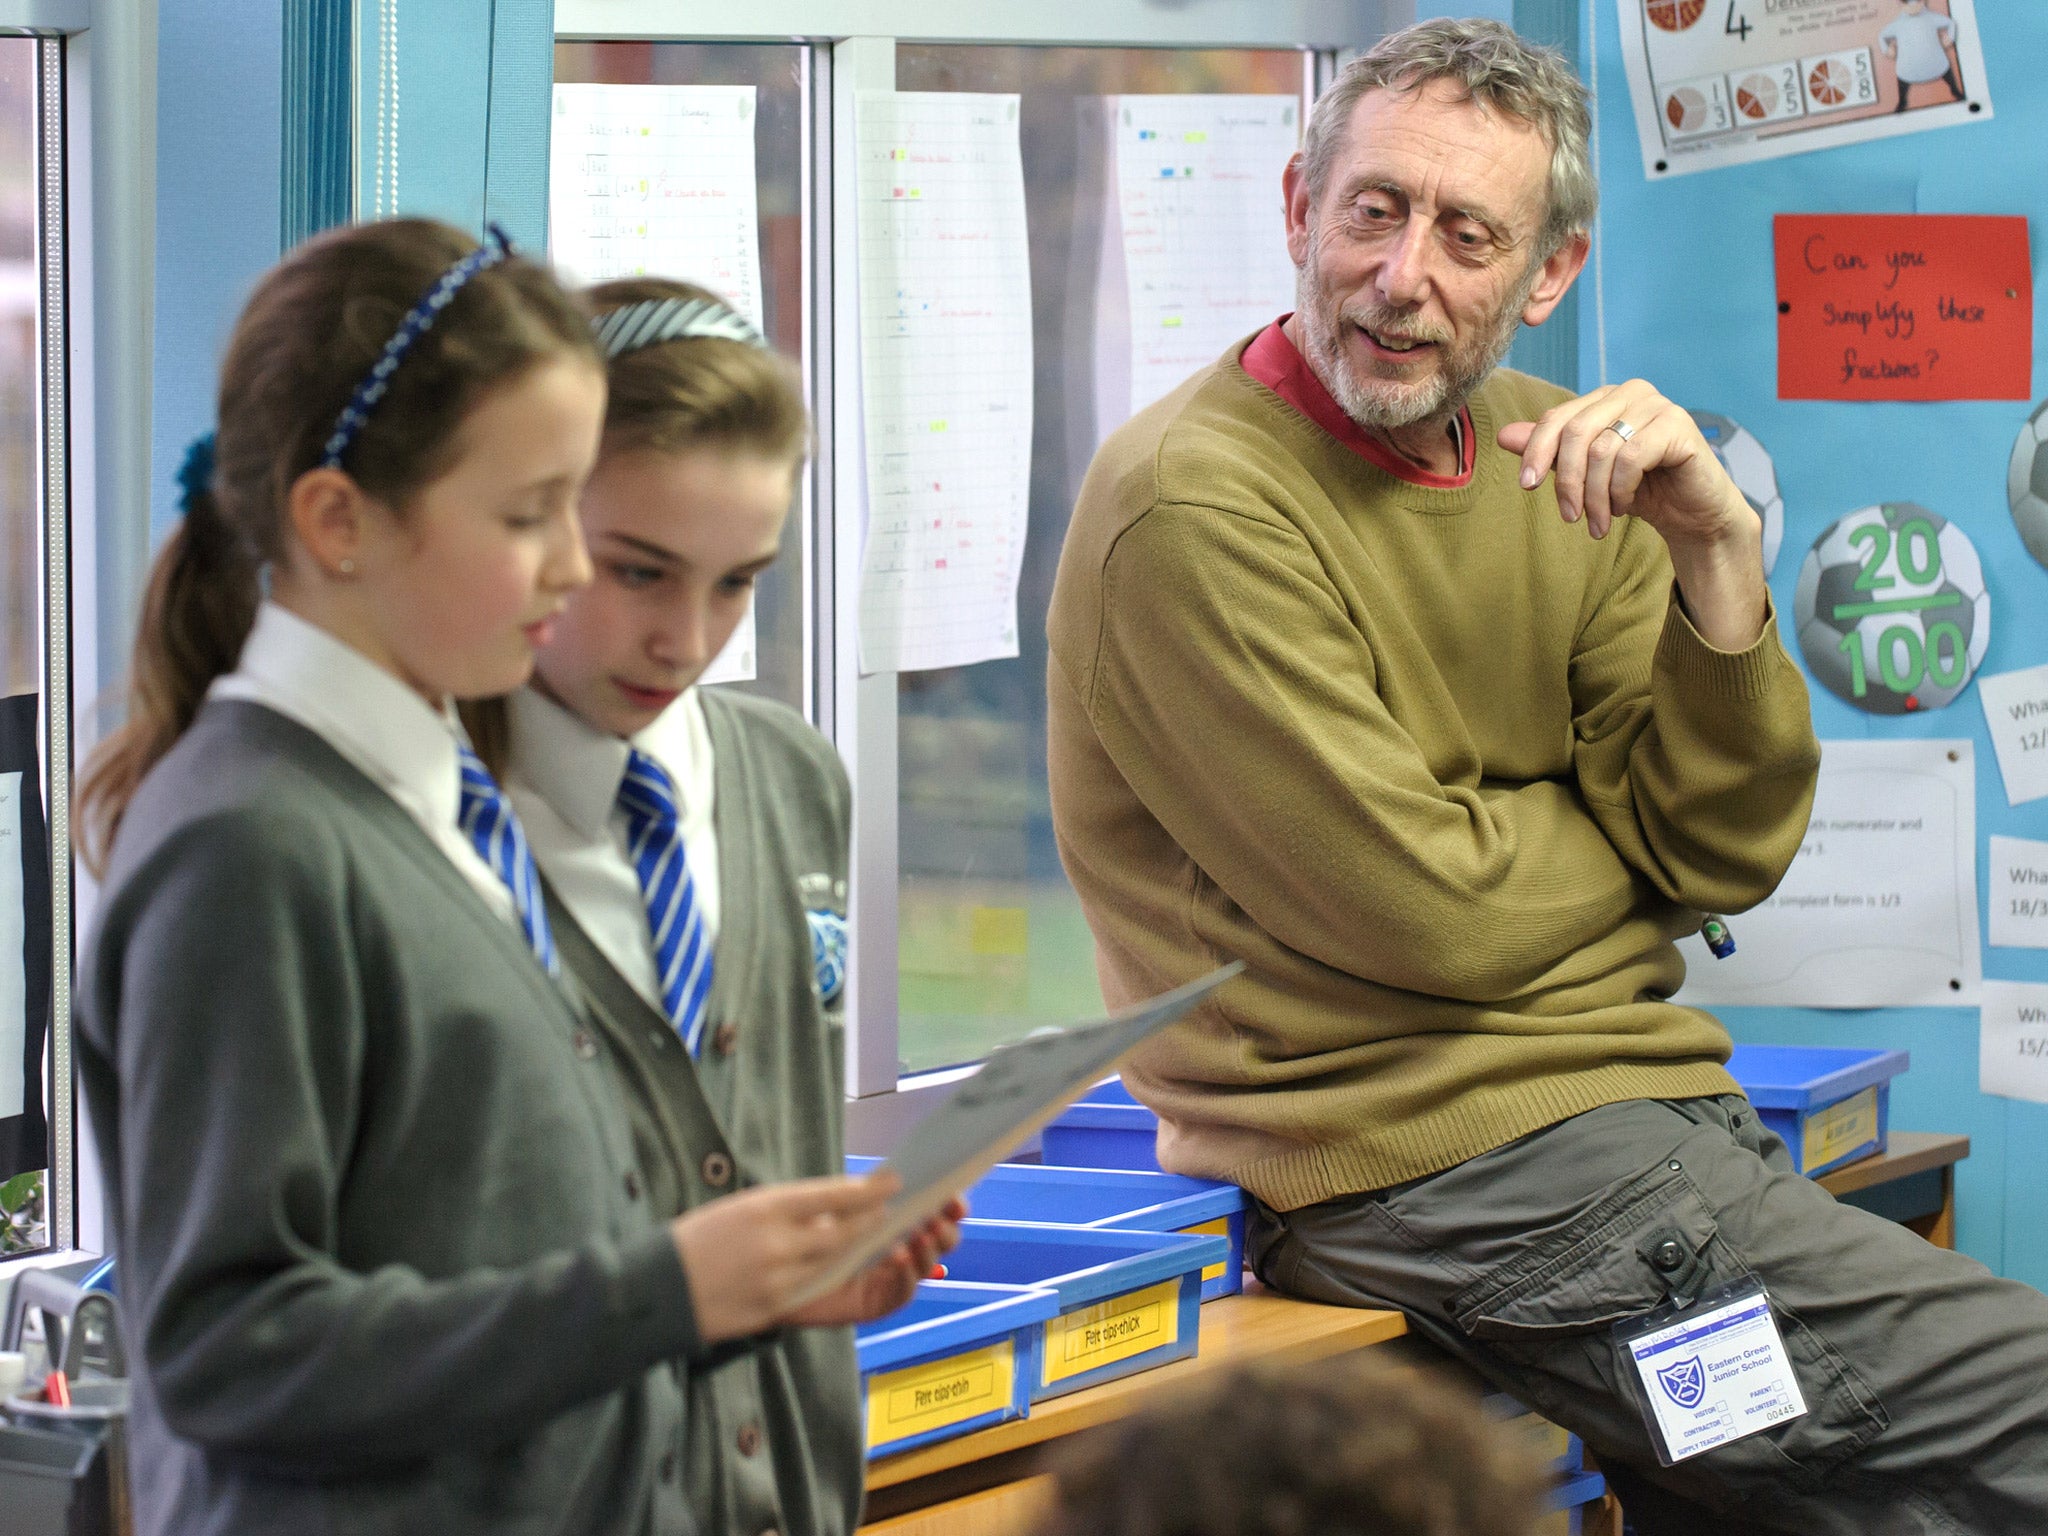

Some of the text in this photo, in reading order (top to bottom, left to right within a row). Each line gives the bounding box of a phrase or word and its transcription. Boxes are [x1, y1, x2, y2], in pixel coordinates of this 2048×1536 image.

[1725, 0, 1753, 42] 4
[1855, 53, 1867, 73] 5
[1783, 67, 1795, 84] 2
[1858, 78, 1872, 100] 8
[1713, 105, 1727, 130] 3
[1803, 233, 1928, 291] Can you
[1938, 296, 1986, 323] these
[1848, 517, 1941, 592] 20
[1837, 620, 1967, 698] 100
[2020, 727, 2048, 752] 12/
[2018, 1038, 2048, 1058] 15/
[1085, 1328, 1101, 1349] Felt
[1707, 1344, 1771, 1372] Eastern Green
[1712, 1354, 1773, 1383] Junior School
[914, 1389, 932, 1411] Felt
[1749, 1385, 1772, 1398] PARENT
[1694, 1406, 1717, 1419] VISITOR
[1744, 1398, 1777, 1415] VOLUNTEER
[1766, 1403, 1796, 1421] 00445
[1683, 1419, 1722, 1438] CONTRACTOR
[1677, 1433, 1726, 1456] SUPPLY TEACHER
